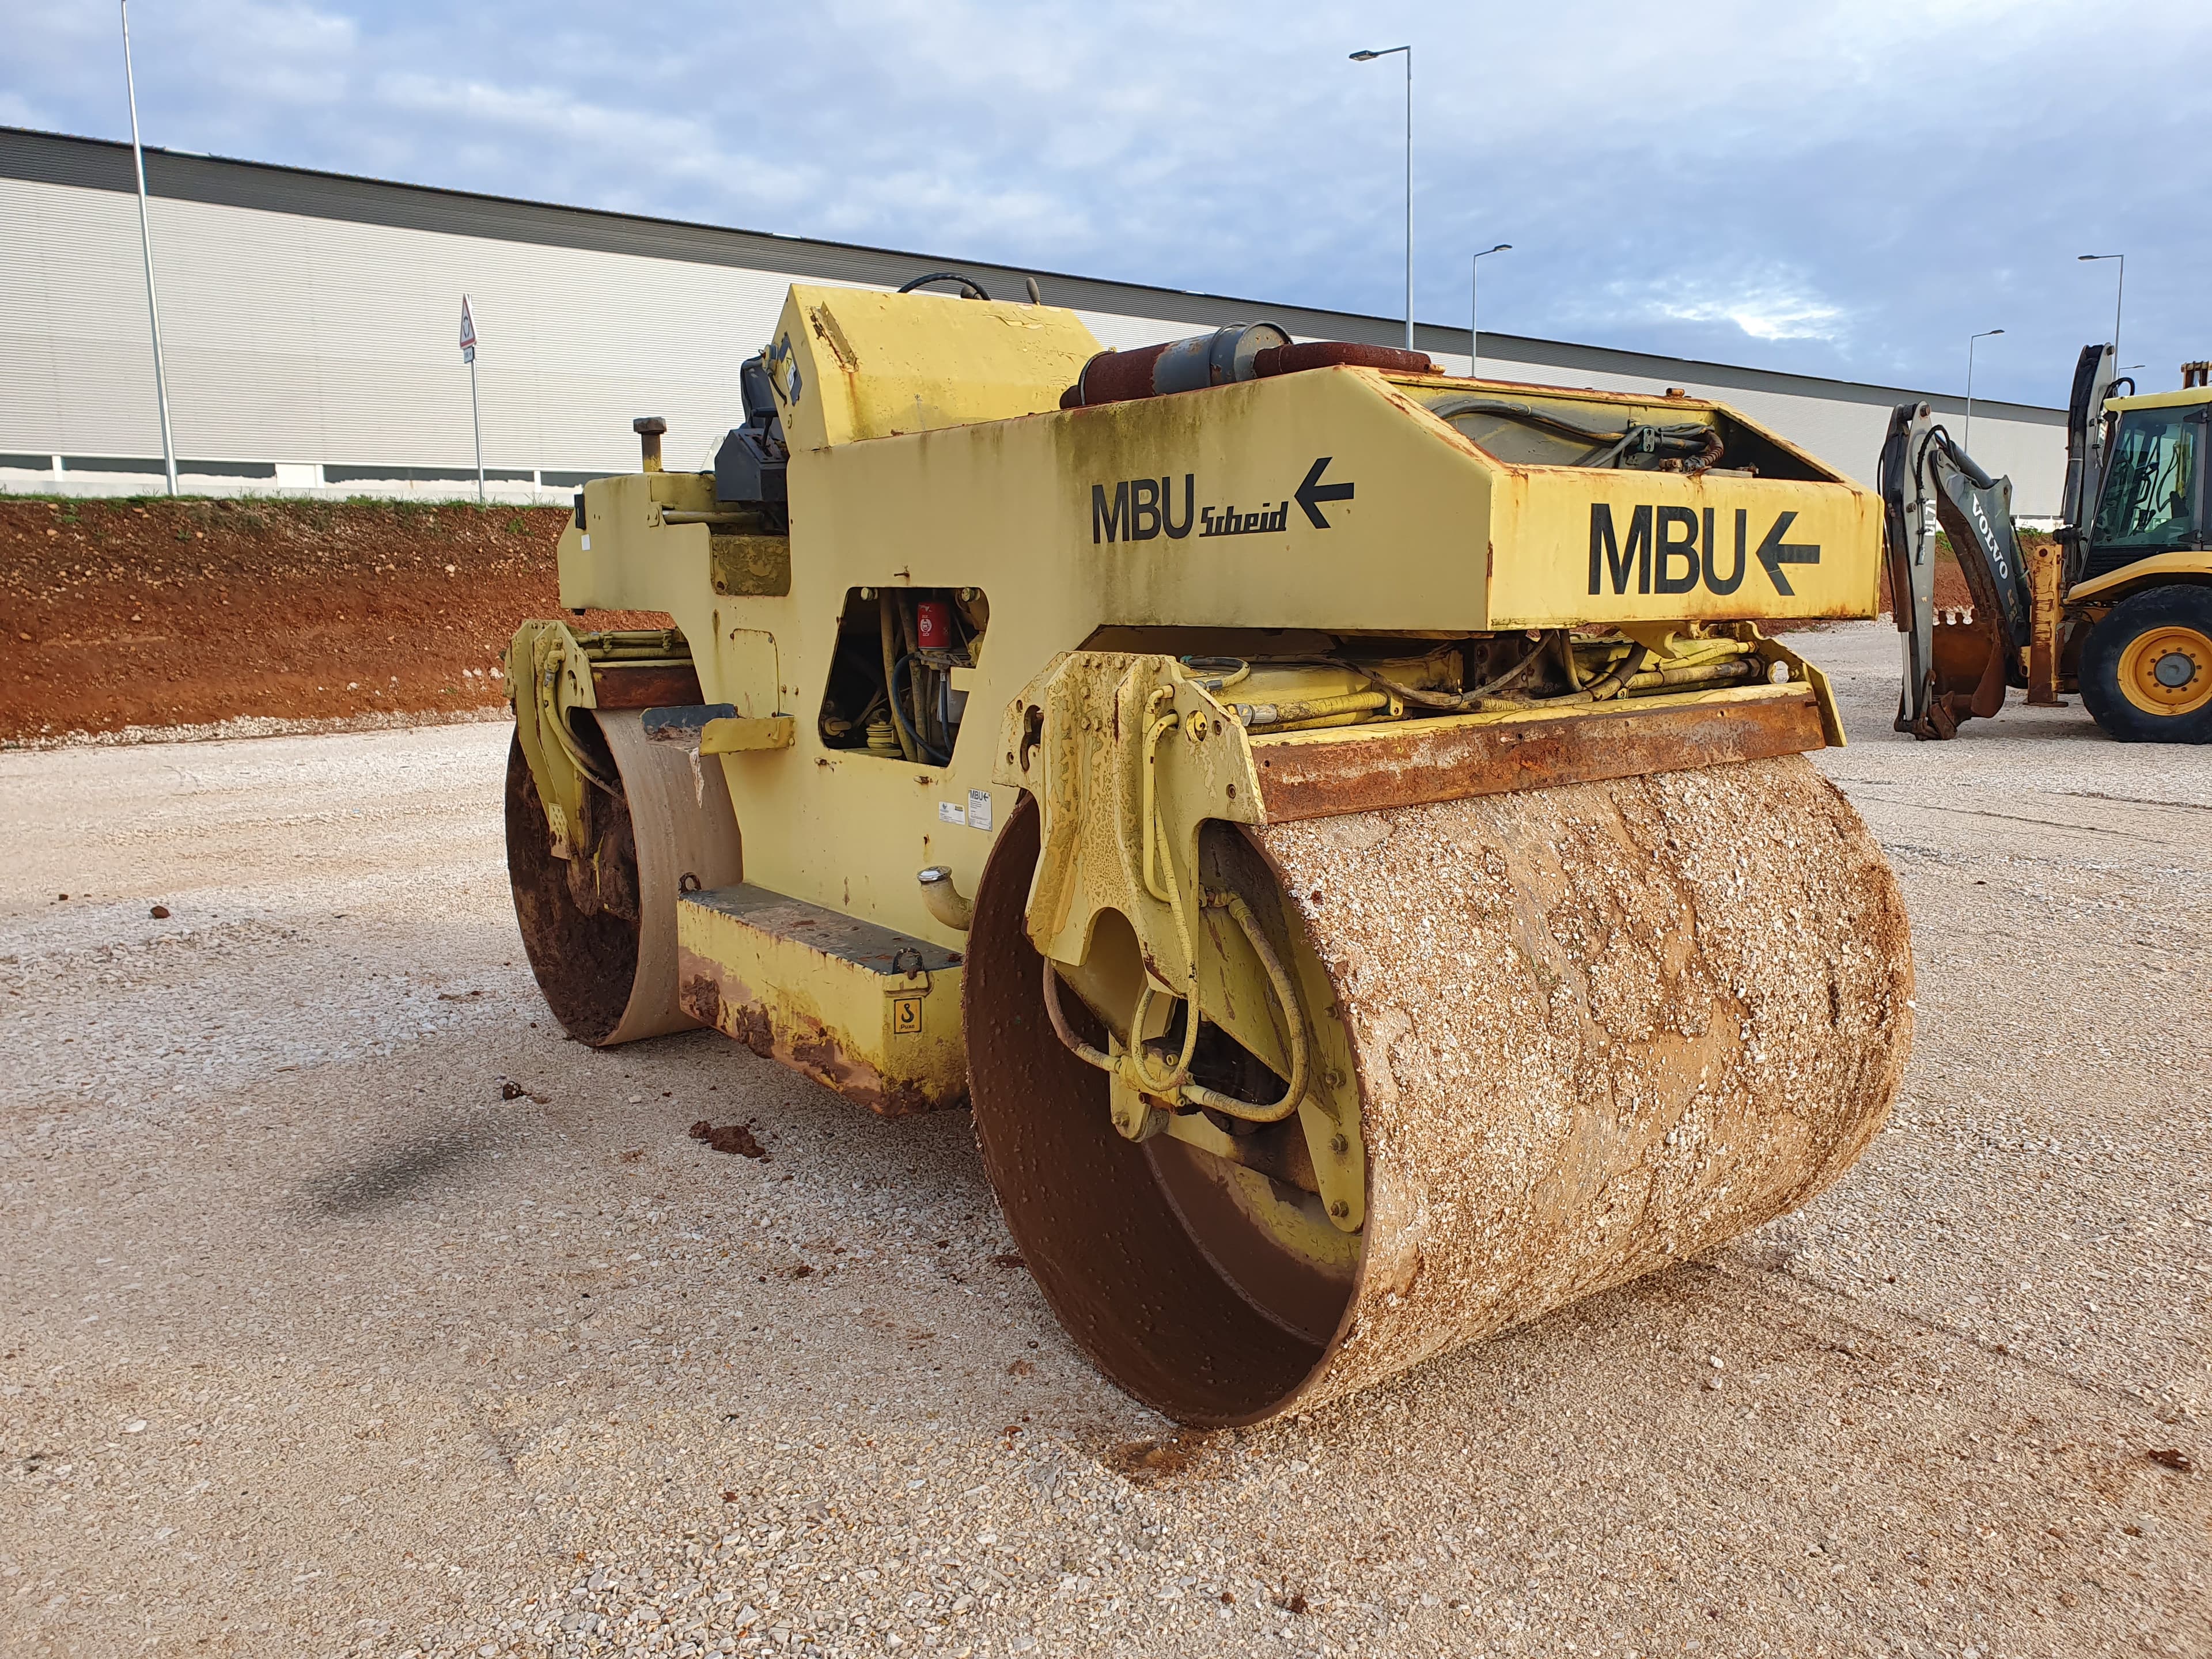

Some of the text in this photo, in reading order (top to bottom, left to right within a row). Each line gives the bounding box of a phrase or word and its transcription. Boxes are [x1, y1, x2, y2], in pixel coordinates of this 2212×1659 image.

[1092, 474, 1289, 544] MBU Scheid
[1972, 493, 2008, 579] VOLVO
[1588, 503, 1747, 596] MBU
[970, 790, 983, 801] MBU
